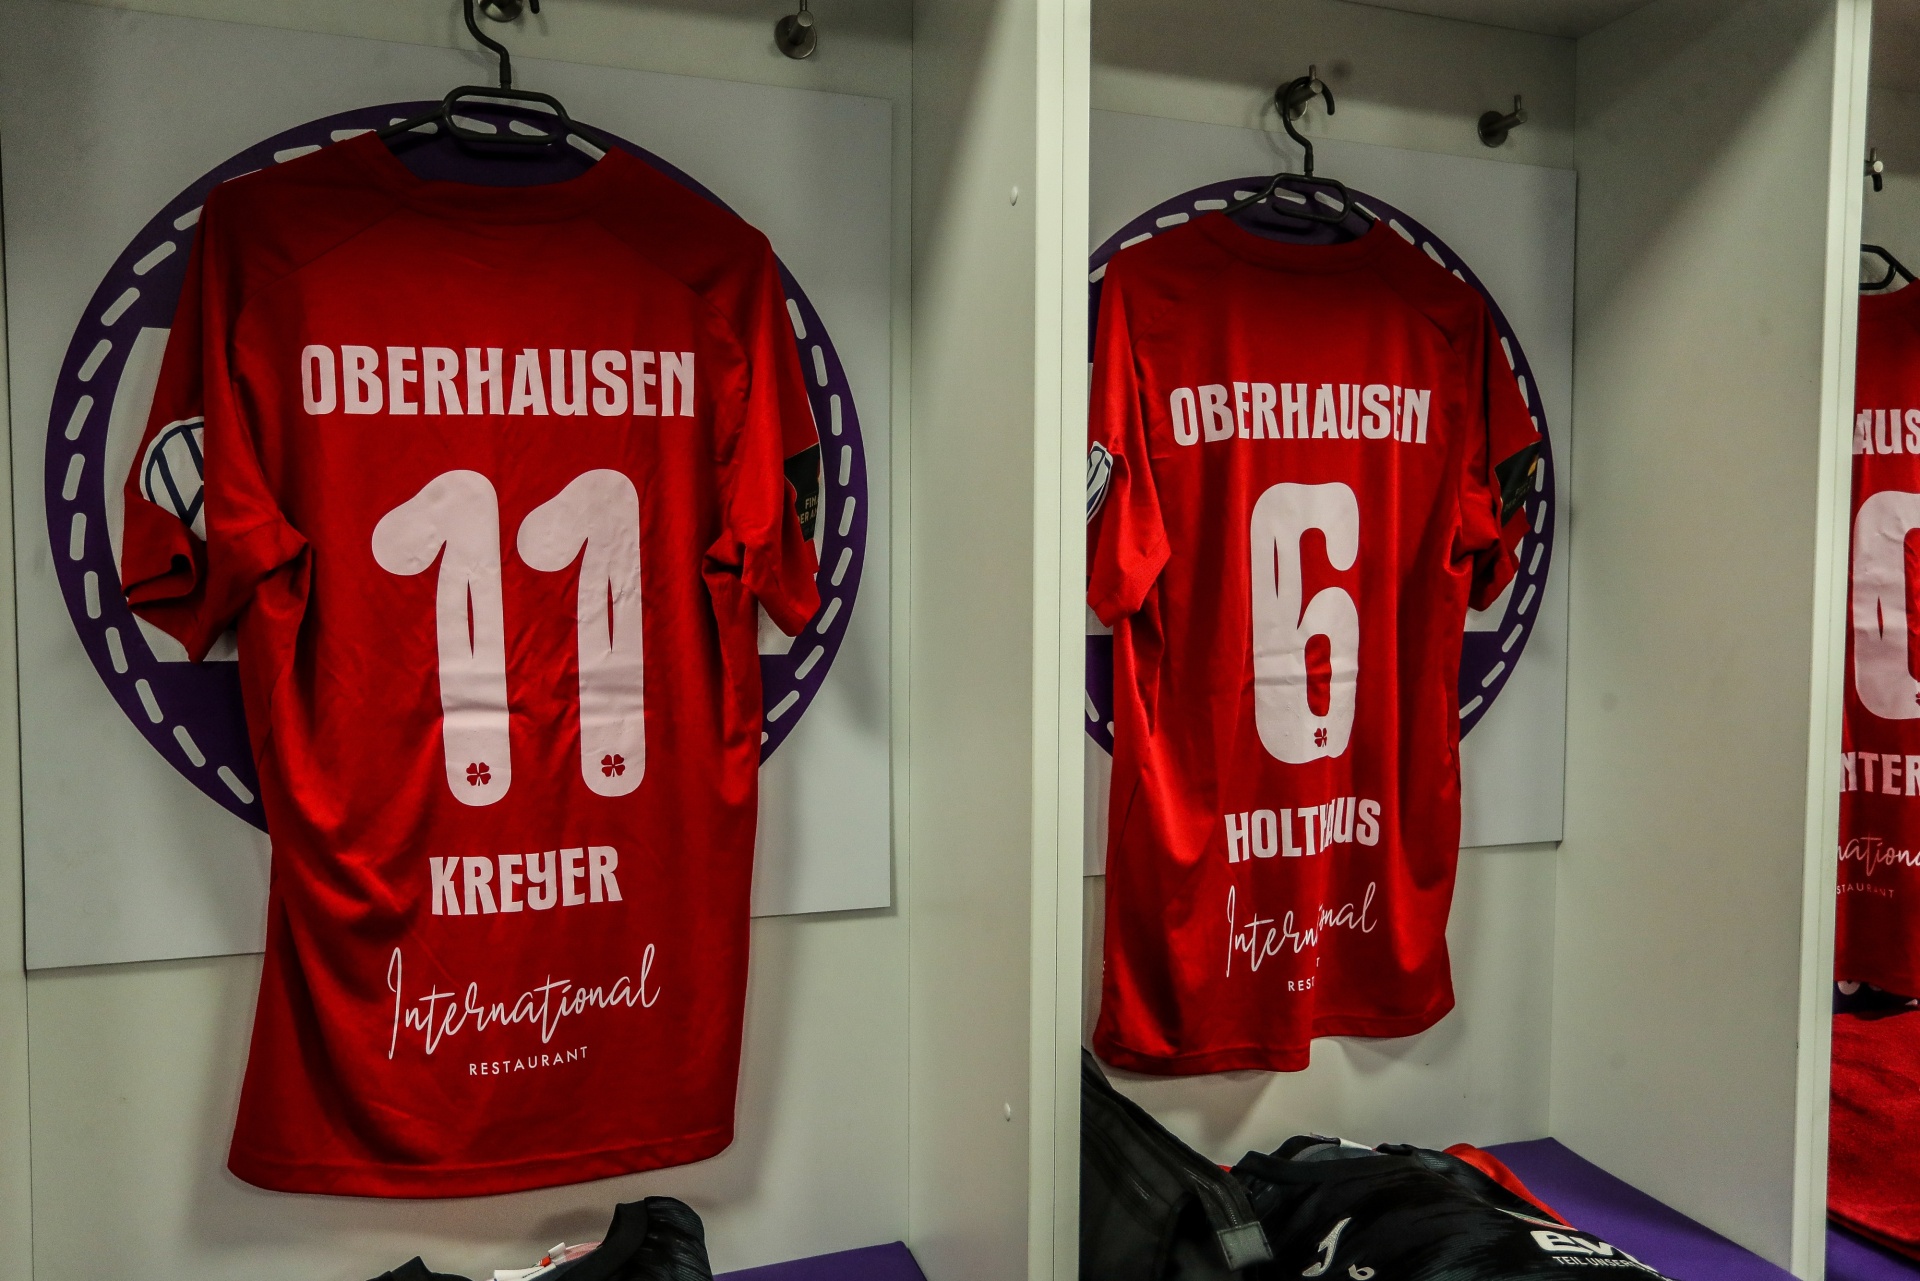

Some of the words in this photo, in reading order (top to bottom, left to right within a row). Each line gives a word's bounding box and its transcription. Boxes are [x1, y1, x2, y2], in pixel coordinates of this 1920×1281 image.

[301, 344, 696, 418] OBERHAUSEN
[1169, 381, 1432, 447] OBERHAUSEN
[372, 468, 646, 807] 11
[1250, 481, 1360, 765] 6
[1223, 796, 1381, 864] HOLTHAUS
[428, 845, 623, 916] KREYER
[386, 943, 661, 1060] International
[469, 1046, 589, 1077] RESTAURANT
[1552, 1255, 1587, 1266] TEIL
